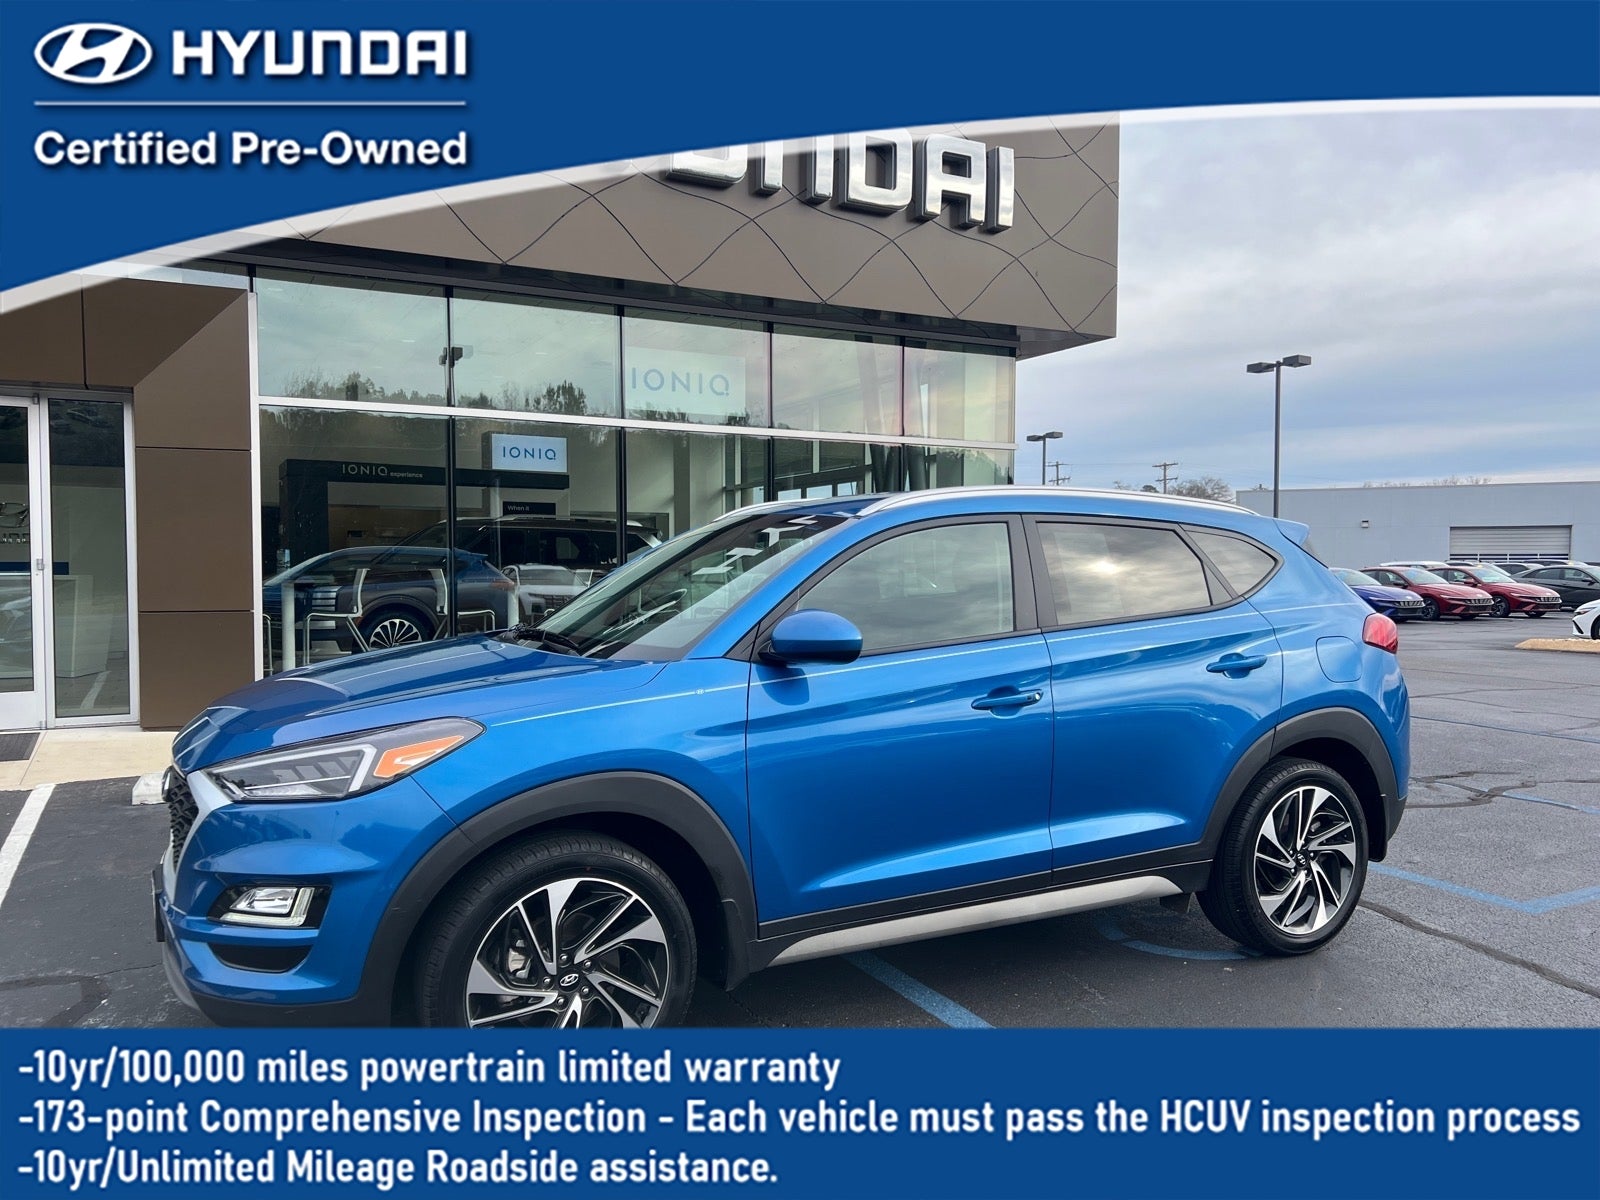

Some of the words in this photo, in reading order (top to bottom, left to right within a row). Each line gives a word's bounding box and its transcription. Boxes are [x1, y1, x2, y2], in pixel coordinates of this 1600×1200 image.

[631, 367, 730, 397] IONIQ
[502, 446, 557, 461] IONIQ
[342, 463, 388, 476] IONIQ
